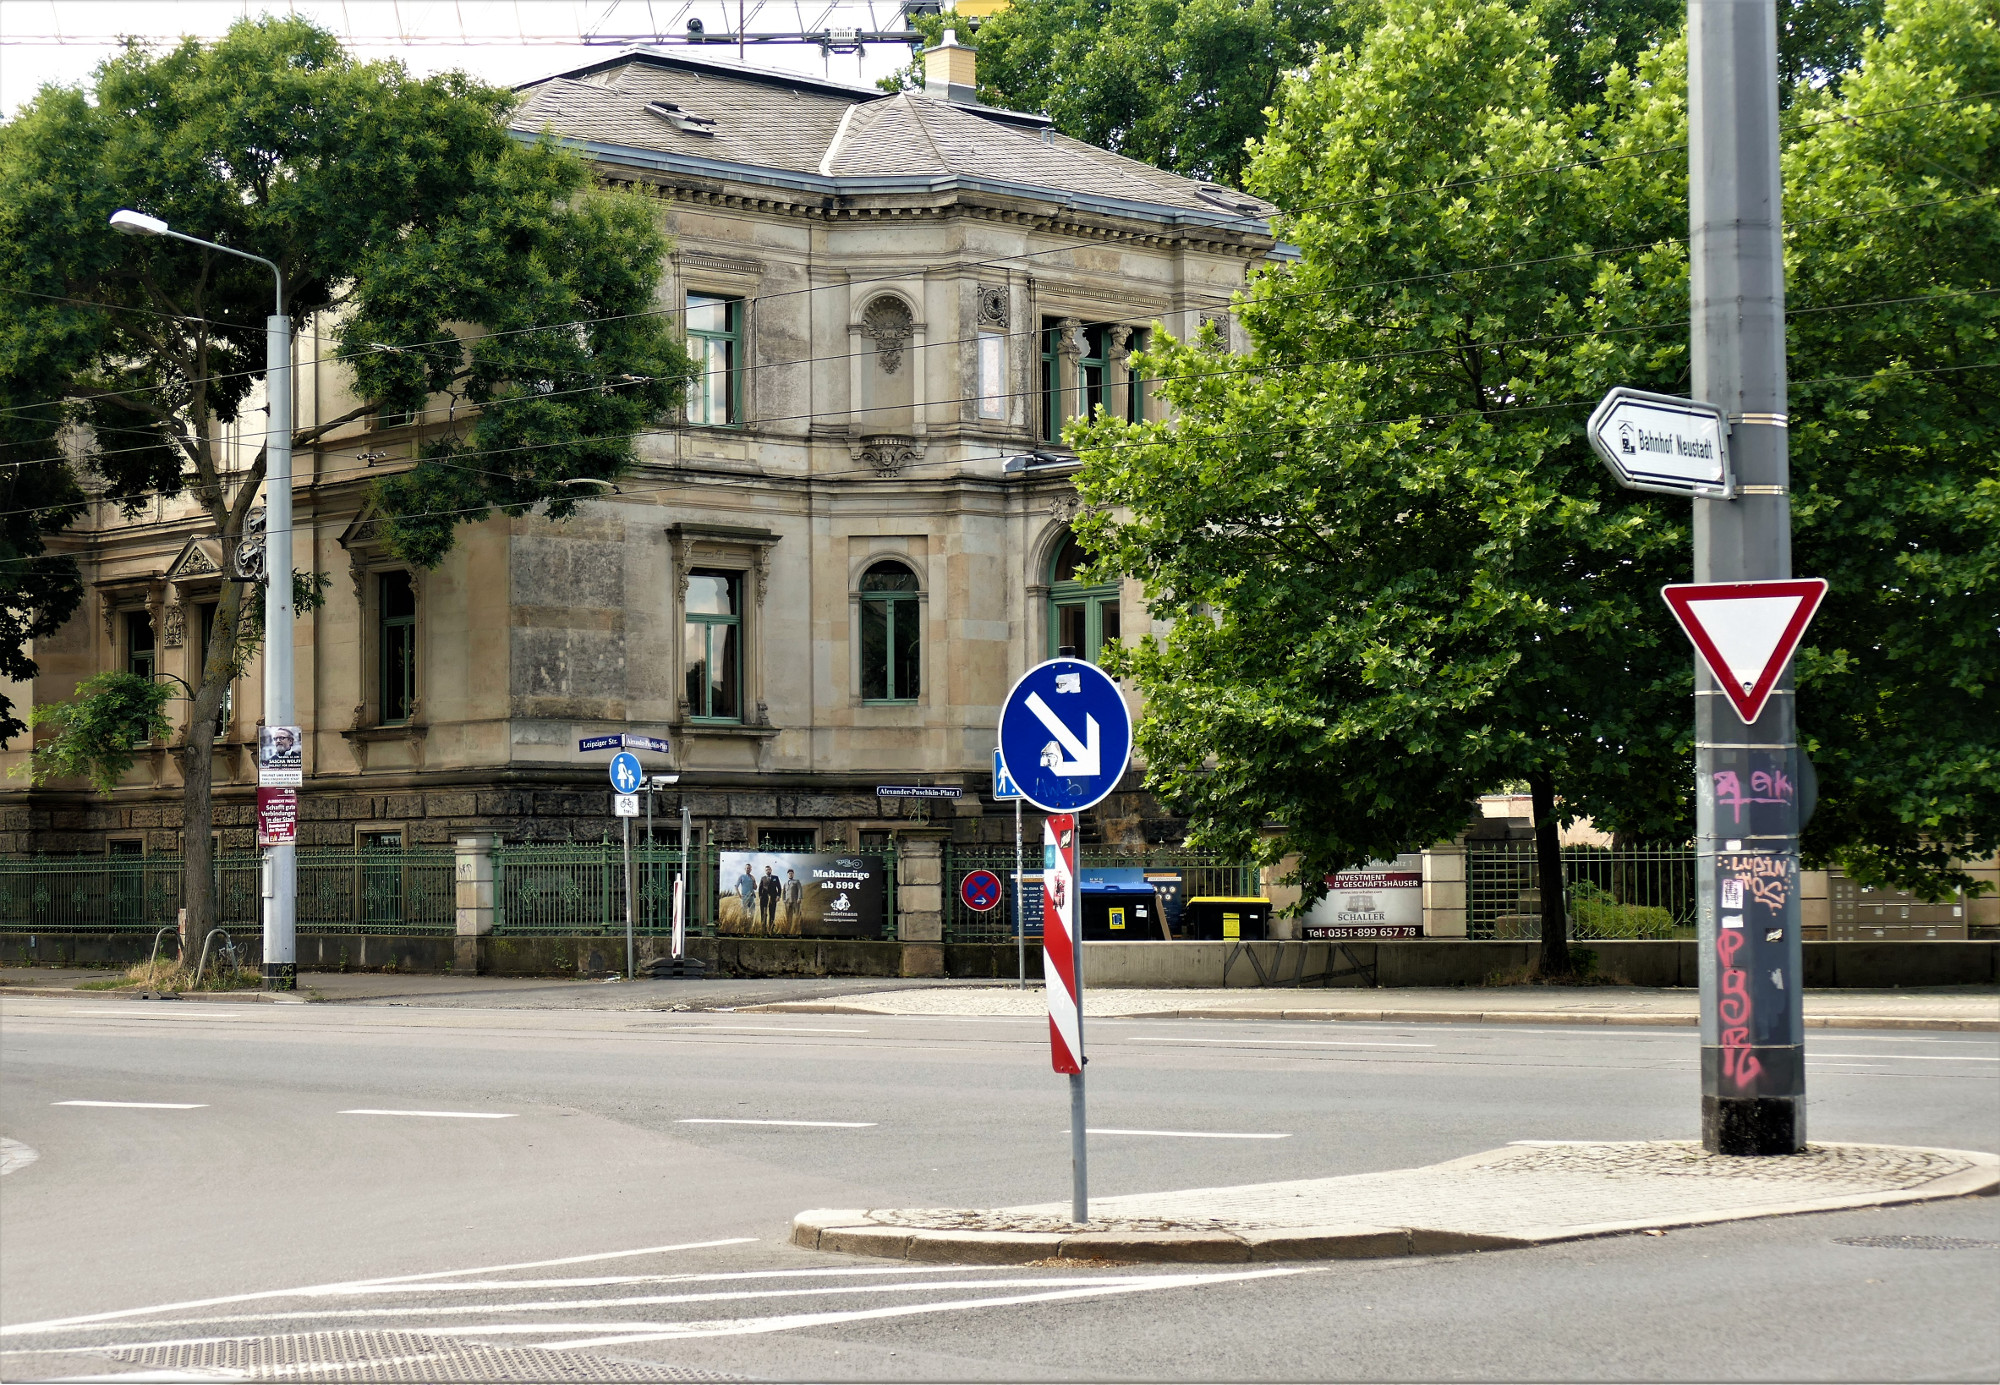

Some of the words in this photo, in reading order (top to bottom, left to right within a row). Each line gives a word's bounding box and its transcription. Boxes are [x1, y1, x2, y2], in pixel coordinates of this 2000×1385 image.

[1638, 428, 1673, 454] Bahnhof
[1676, 433, 1713, 460] Neustadt
[583, 739, 607, 749] Leipziger
[608, 738, 618, 746] Str.
[880, 788, 955, 797] Alexander-Puschkin-Platz
[812, 869, 870, 881] Maßanzüge
[821, 880, 834, 889] ab
[1342, 879, 1419, 888] GESCHÄFTSHÄUSER
[1337, 913, 1385, 921] SCHALLER
[1307, 928, 1325, 938] Tel:
[1328, 927, 1377, 938] 0351-899
[1380, 927, 1400, 937] 657
[1403, 927, 1416, 936] 78
